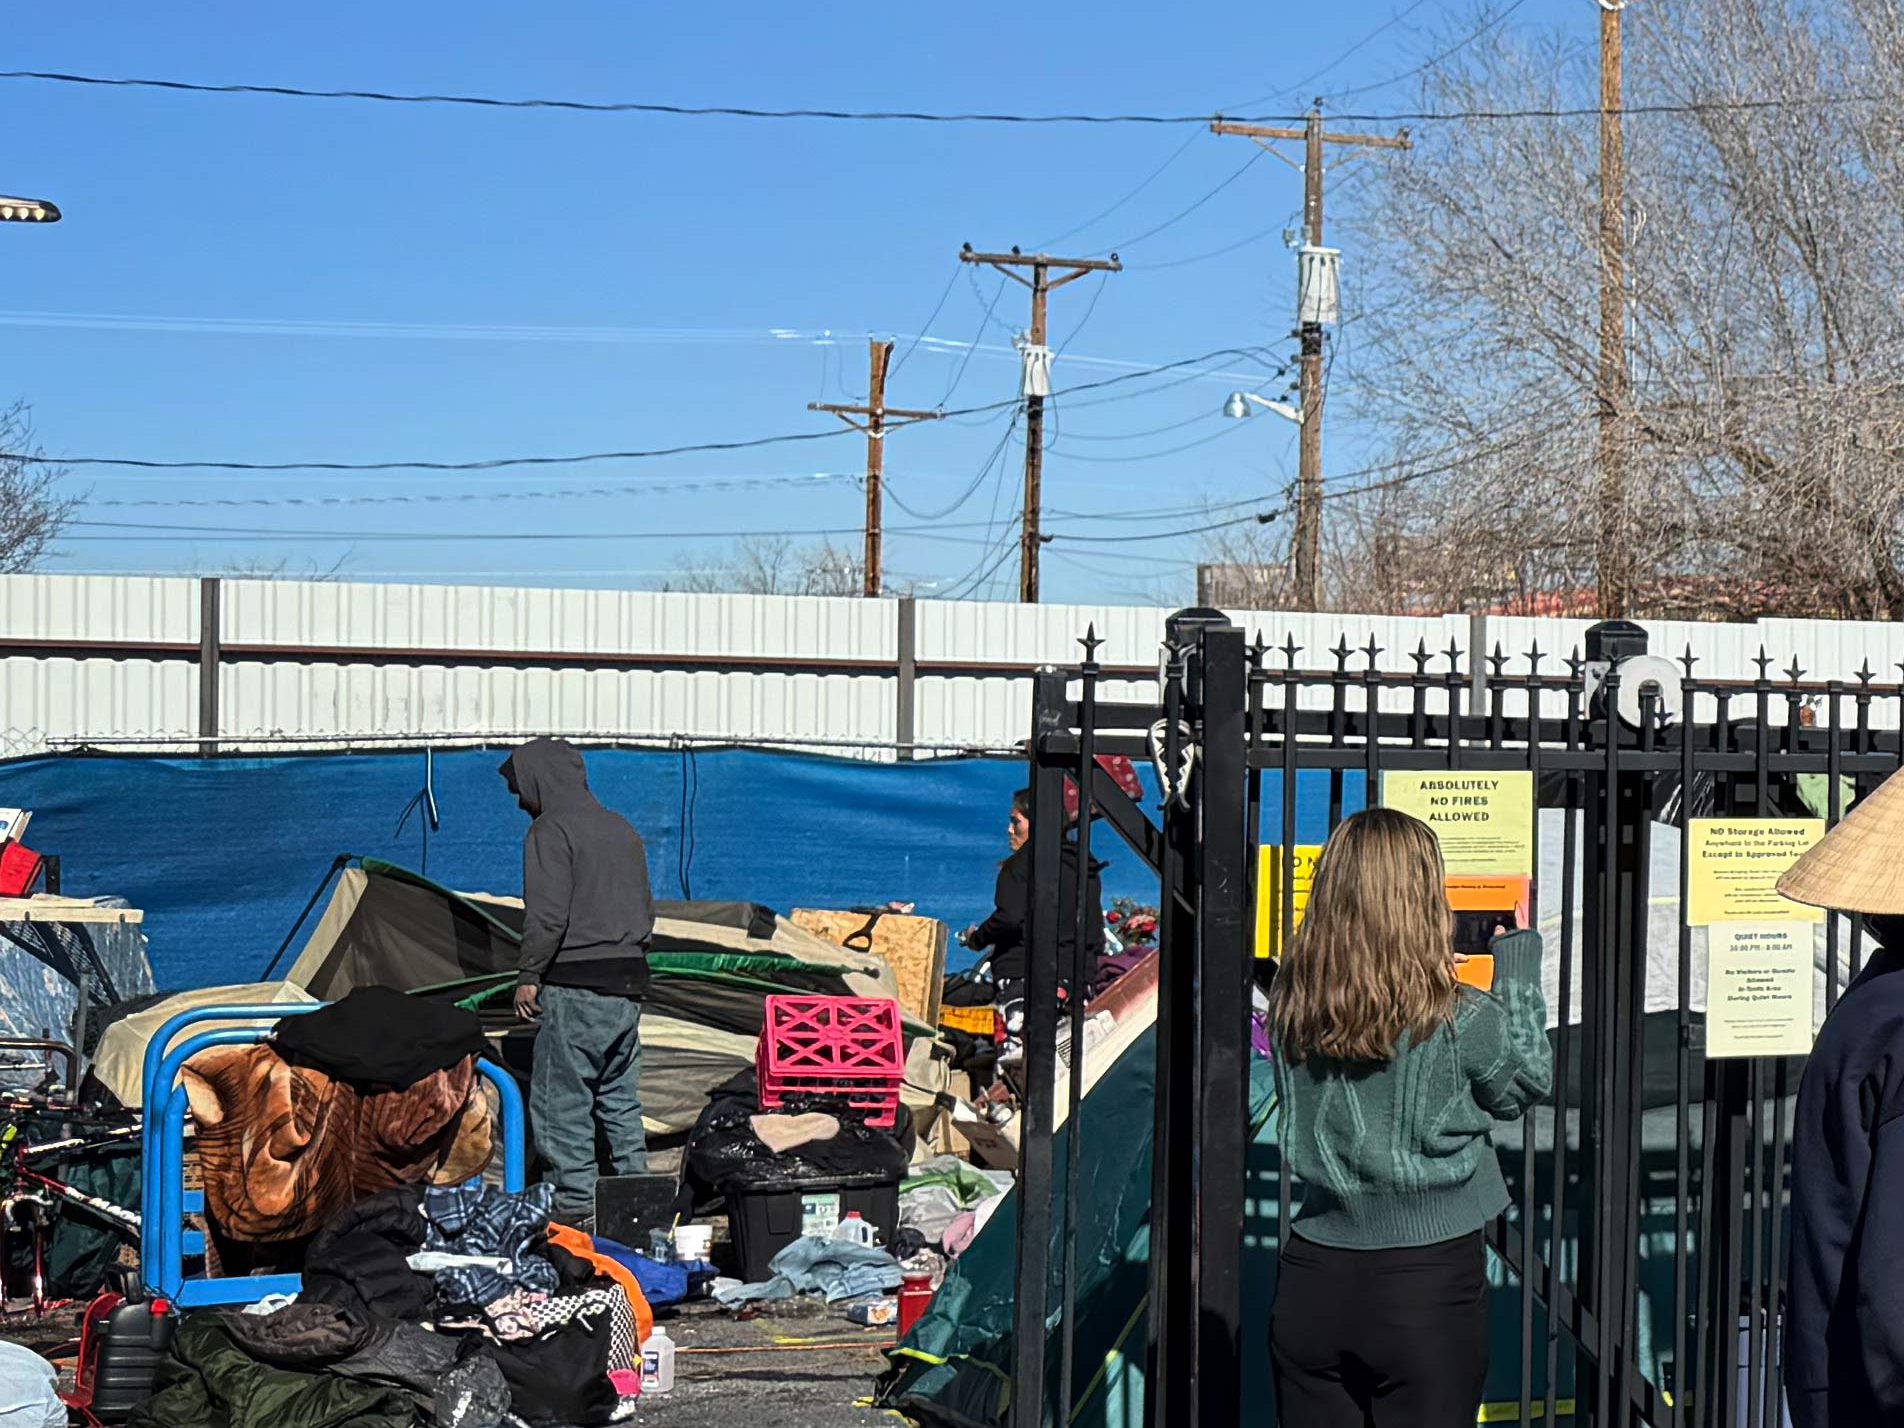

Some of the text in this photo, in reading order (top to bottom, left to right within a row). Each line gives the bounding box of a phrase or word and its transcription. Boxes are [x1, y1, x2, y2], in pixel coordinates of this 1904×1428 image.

[1419, 780, 1500, 790] ABSOLUTELY
[1430, 796, 1489, 806] NO FIRES
[1429, 811, 1490, 822] ALLOWED
[1727, 827, 1765, 837] Storage
